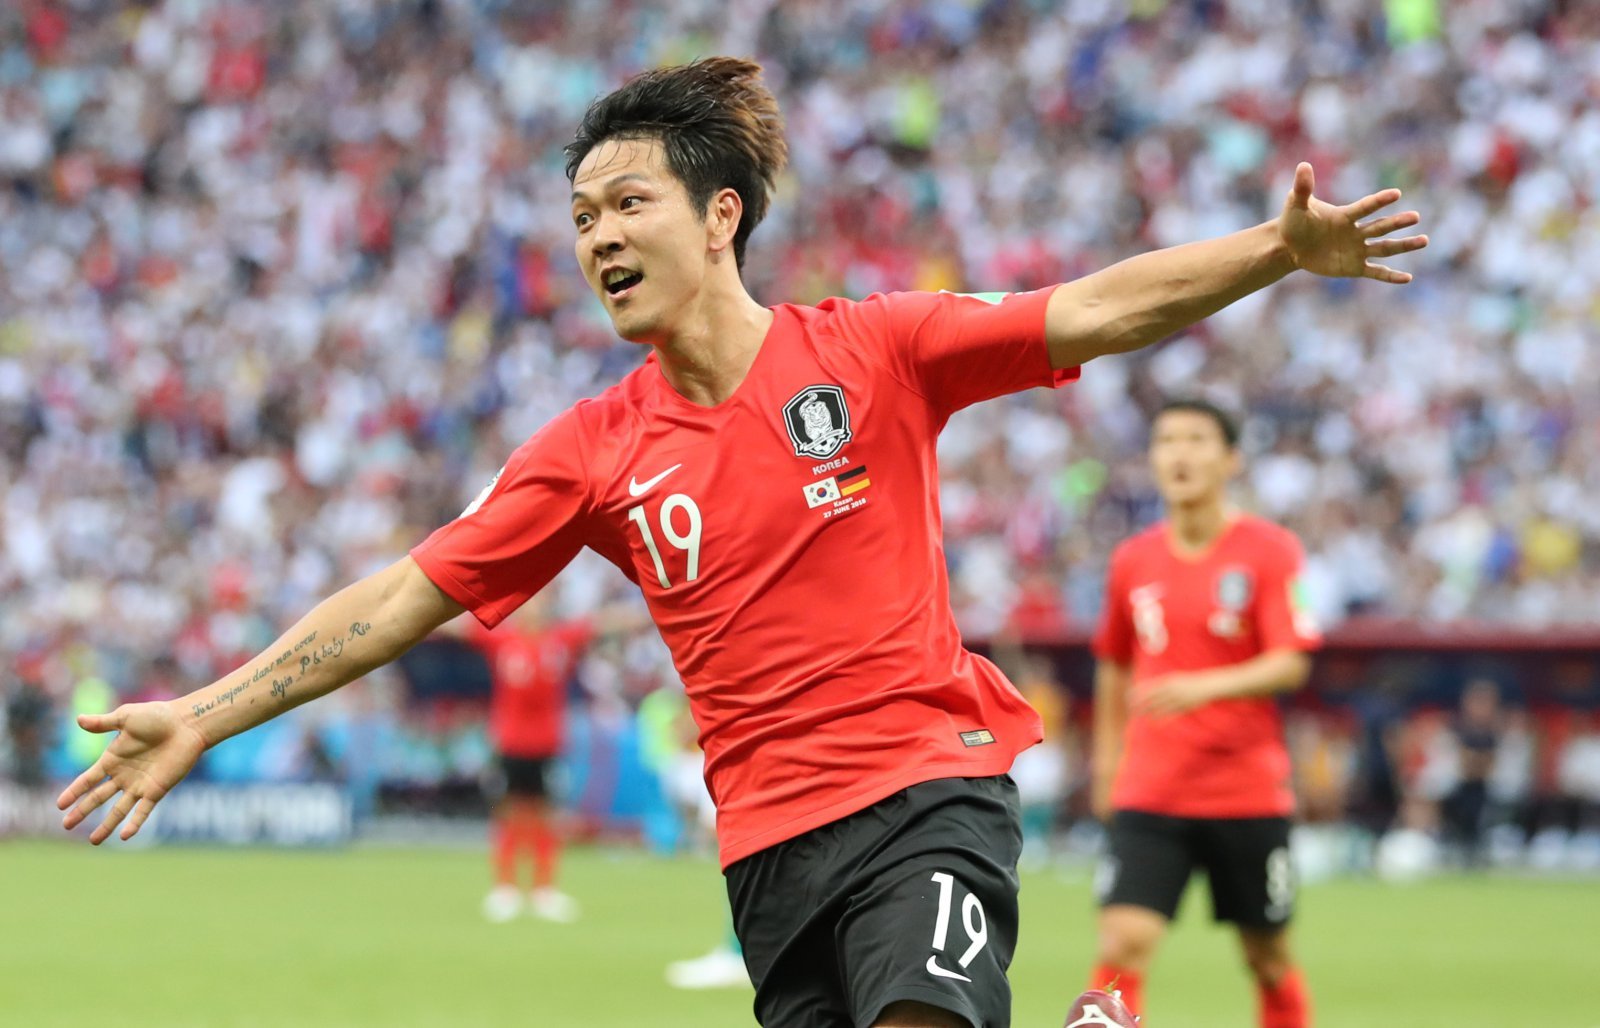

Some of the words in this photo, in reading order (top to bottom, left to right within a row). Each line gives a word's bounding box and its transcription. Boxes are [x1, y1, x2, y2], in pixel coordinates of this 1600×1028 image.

[812, 456, 850, 475] KOREA
[833, 497, 853, 507] Kazan
[833, 504, 850, 515] JUNE
[851, 497, 867, 508] 2018
[628, 493, 702, 589] 19
[270, 676, 293, 698] Sejin
[322, 637, 345, 657] baby
[348, 622, 371, 641] Ria
[216, 679, 251, 704] toujours
[253, 662, 274, 682] dans
[930, 871, 988, 969] 19
